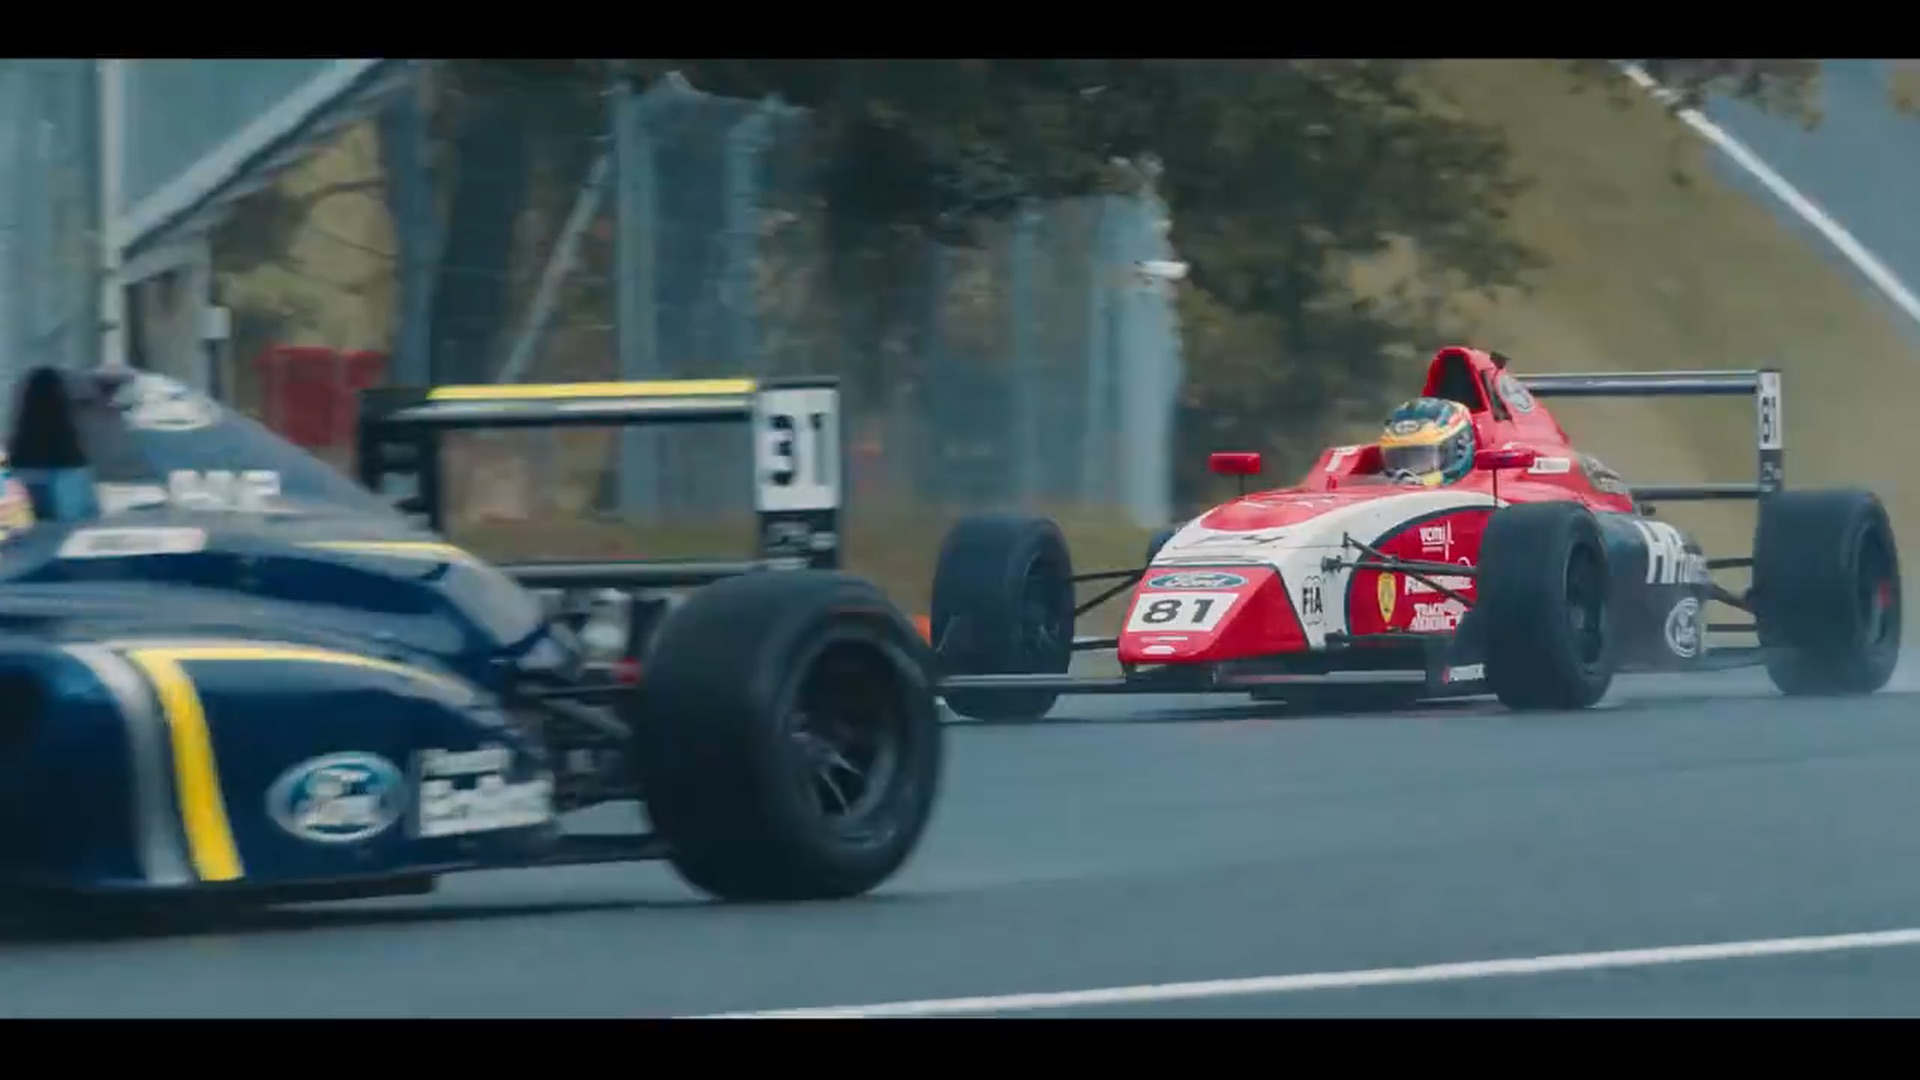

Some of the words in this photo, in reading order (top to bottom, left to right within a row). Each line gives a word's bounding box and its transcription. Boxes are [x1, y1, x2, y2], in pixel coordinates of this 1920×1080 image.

[769, 413, 827, 487] 31
[1142, 599, 1215, 624] 81
[1302, 587, 1323, 615] FIA
